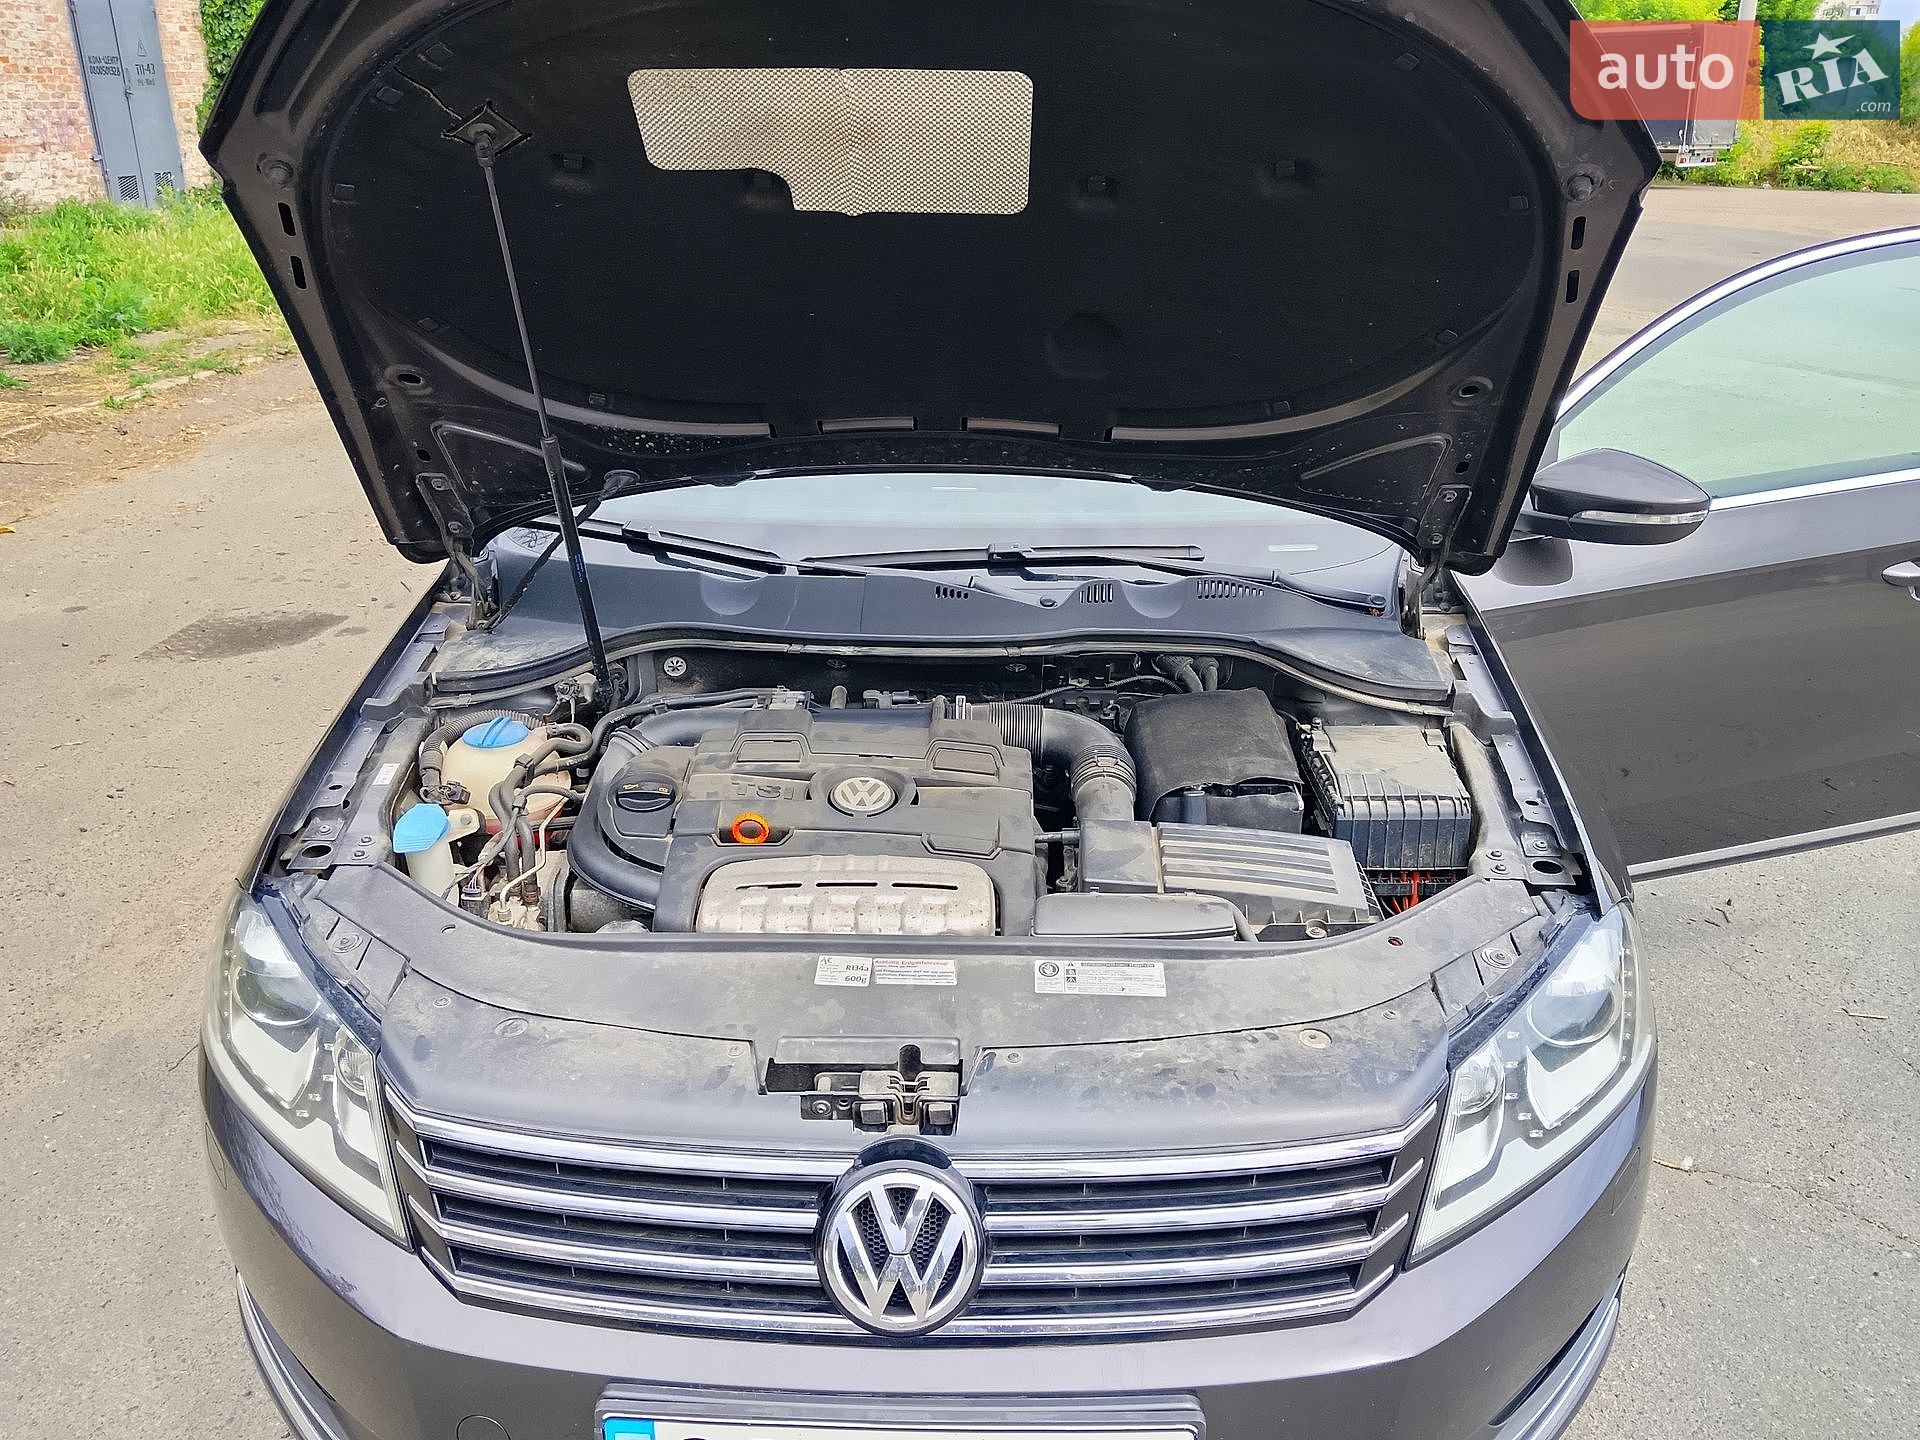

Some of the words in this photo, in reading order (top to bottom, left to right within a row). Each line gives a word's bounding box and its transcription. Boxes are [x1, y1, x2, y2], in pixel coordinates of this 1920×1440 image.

[845, 964, 869, 972] R134a
[844, 975, 867, 984] 600g
[827, 1173, 974, 1328] VW
